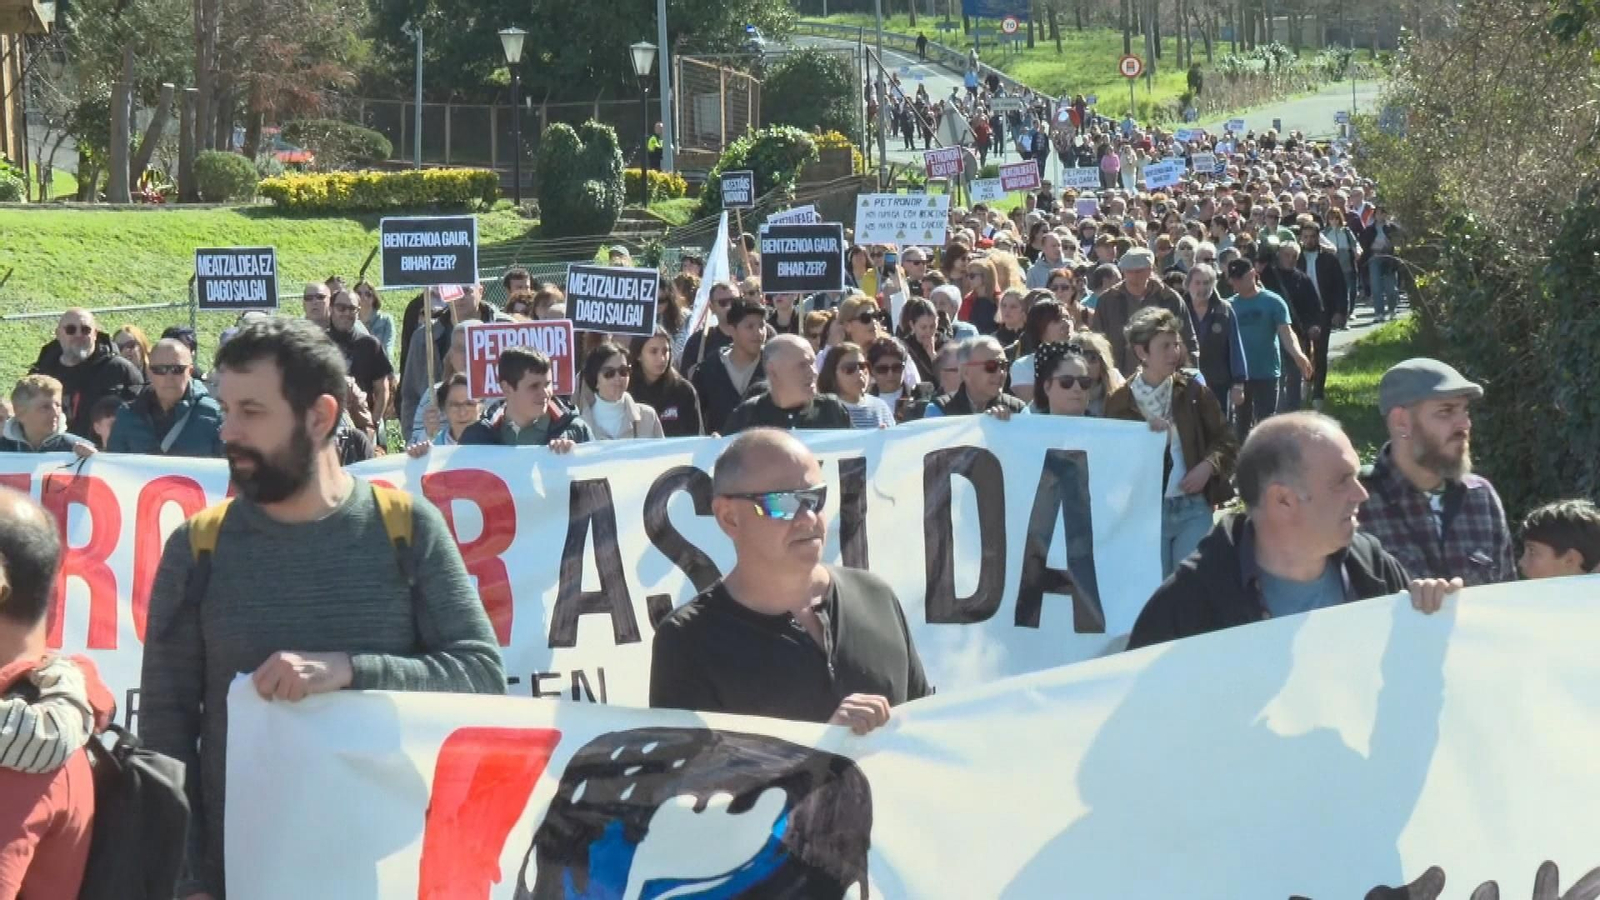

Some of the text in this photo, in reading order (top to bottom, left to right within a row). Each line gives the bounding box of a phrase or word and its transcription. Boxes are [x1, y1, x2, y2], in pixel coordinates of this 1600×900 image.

[874, 198, 922, 206] PETRONOR
[384, 230, 471, 248] BENTZENOA GAUR,
[762, 238, 840, 254] BENTZENOA GAUR,
[198, 254, 273, 276] MEATZALDEA EZ
[401, 254, 456, 271] BIHAR ZER?
[778, 262, 827, 277] BIHAR ZER?
[206, 280, 267, 302] DAGO SALGAI
[569, 272, 655, 301] MEATZALDEA EZ
[576, 299, 644, 327] DAGO SALGAI
[923, 445, 1106, 634] DA
